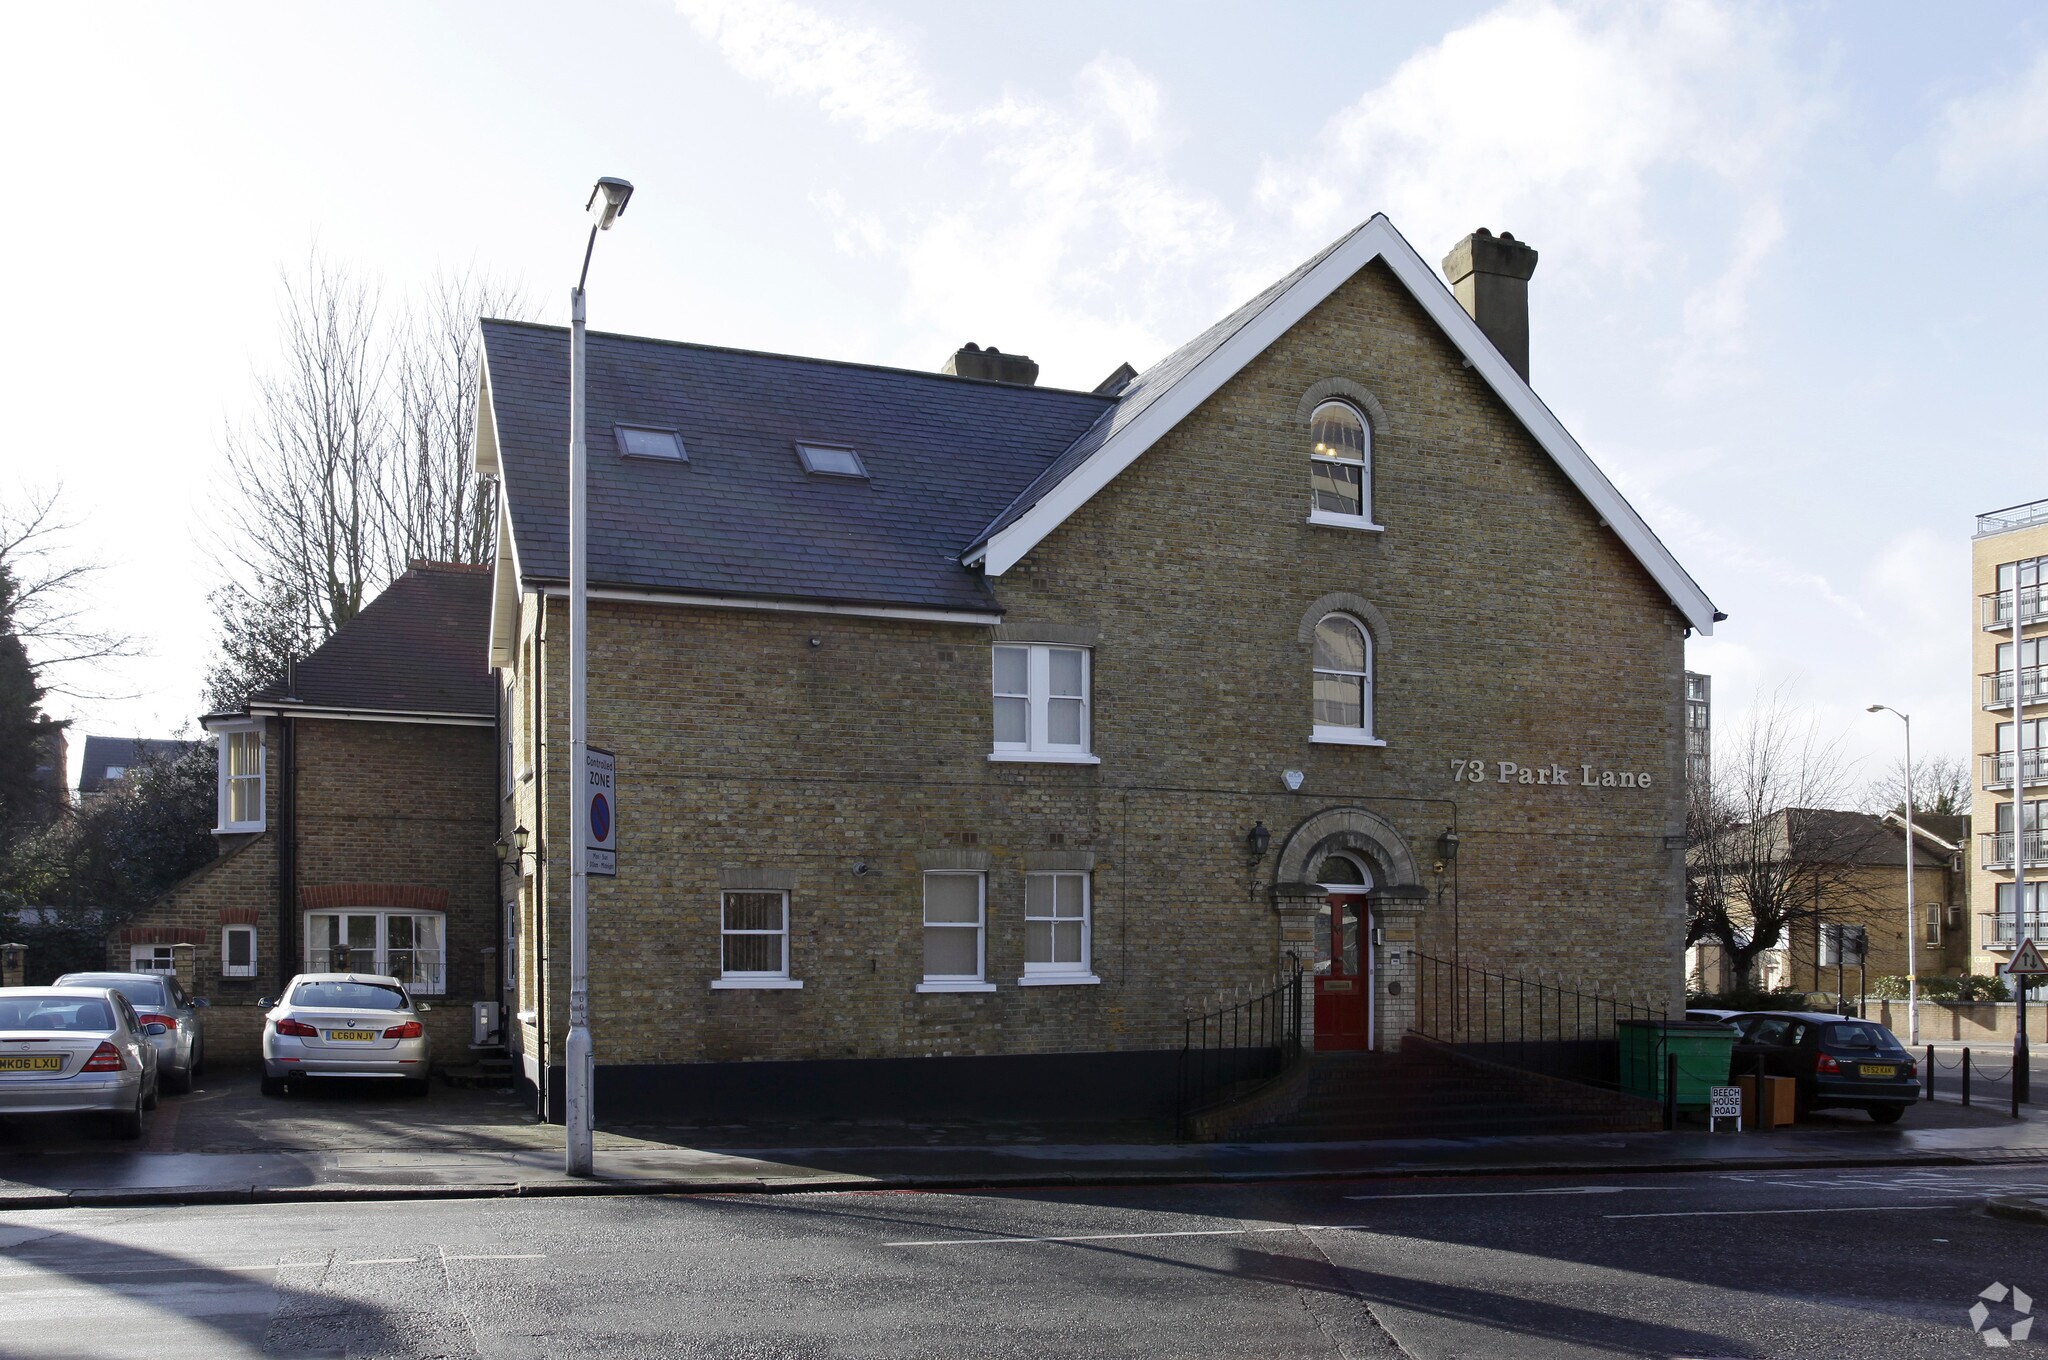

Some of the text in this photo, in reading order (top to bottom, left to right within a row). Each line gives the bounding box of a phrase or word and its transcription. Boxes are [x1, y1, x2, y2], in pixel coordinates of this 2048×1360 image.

[586, 755, 613, 771] Controlled
[1450, 759, 1651, 788] 73 Park Lane
[590, 771, 610, 788] ZONE
[331, 1031, 374, 1040] LC60 NJV
[0, 1058, 58, 1069] MK06 LXU
[1713, 1088, 1740, 1097] BEECH
[1713, 1097, 1740, 1106] HOUSE
[1714, 1106, 1737, 1115] ROAD
